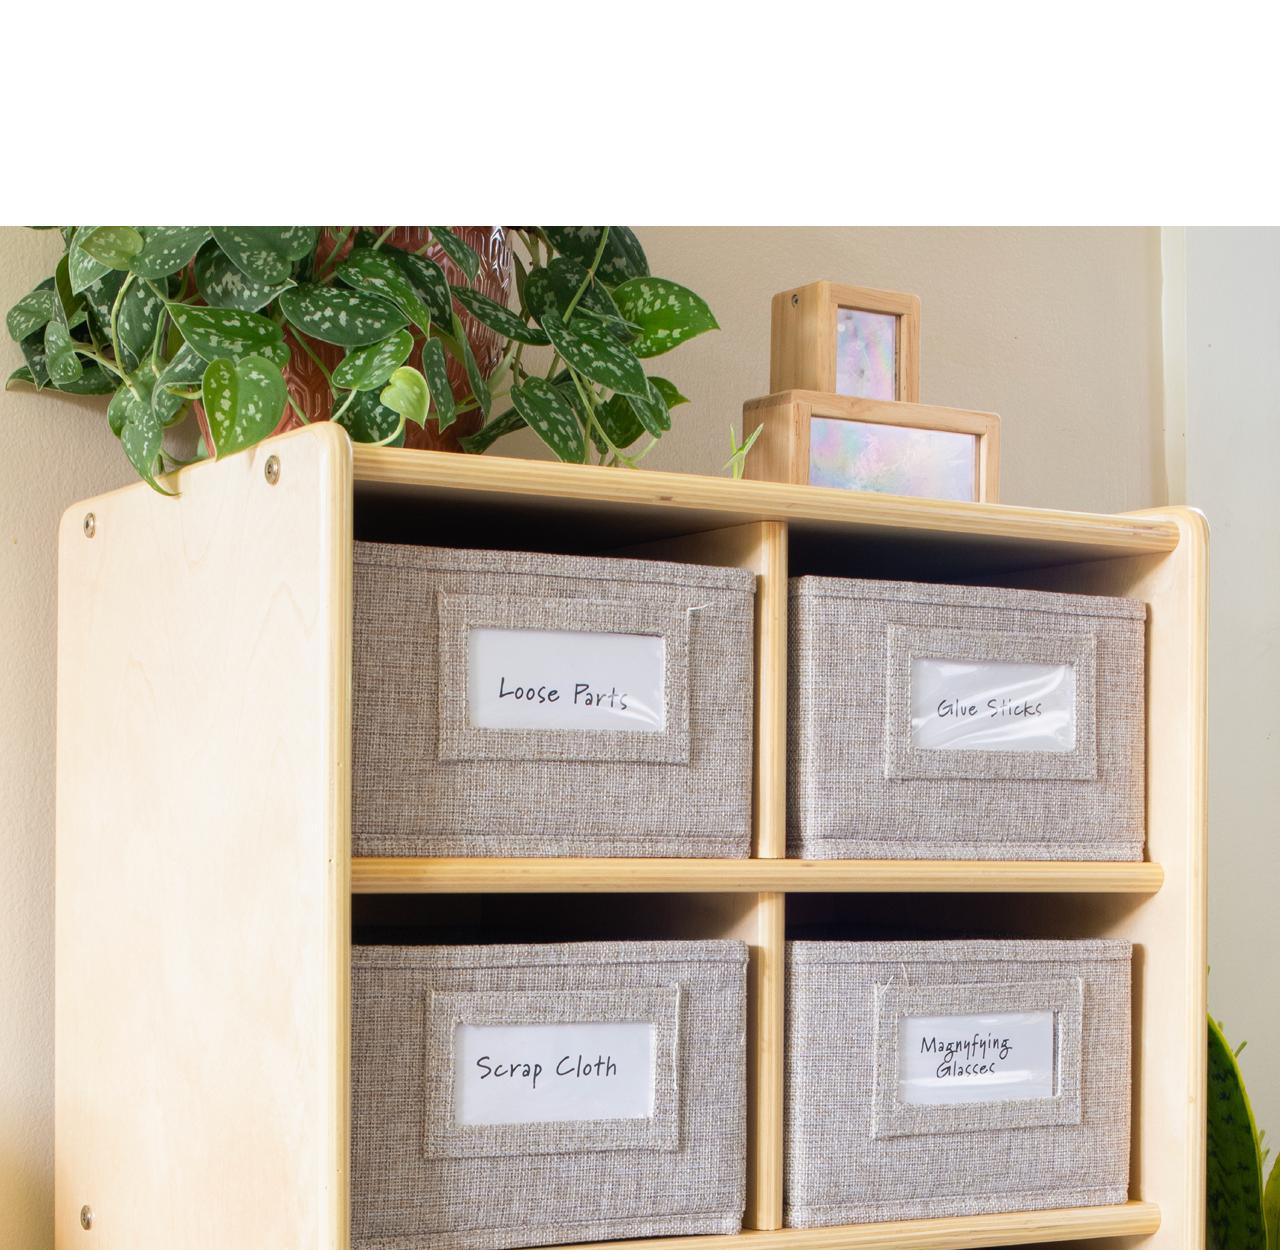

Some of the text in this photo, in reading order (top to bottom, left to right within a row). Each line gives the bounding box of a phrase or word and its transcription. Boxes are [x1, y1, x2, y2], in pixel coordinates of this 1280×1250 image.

[498, 676, 628, 710] Loose Parts
[937, 698, 1042, 718] Glue Sticks
[476, 1054, 617, 1089] Scrap Cloth
